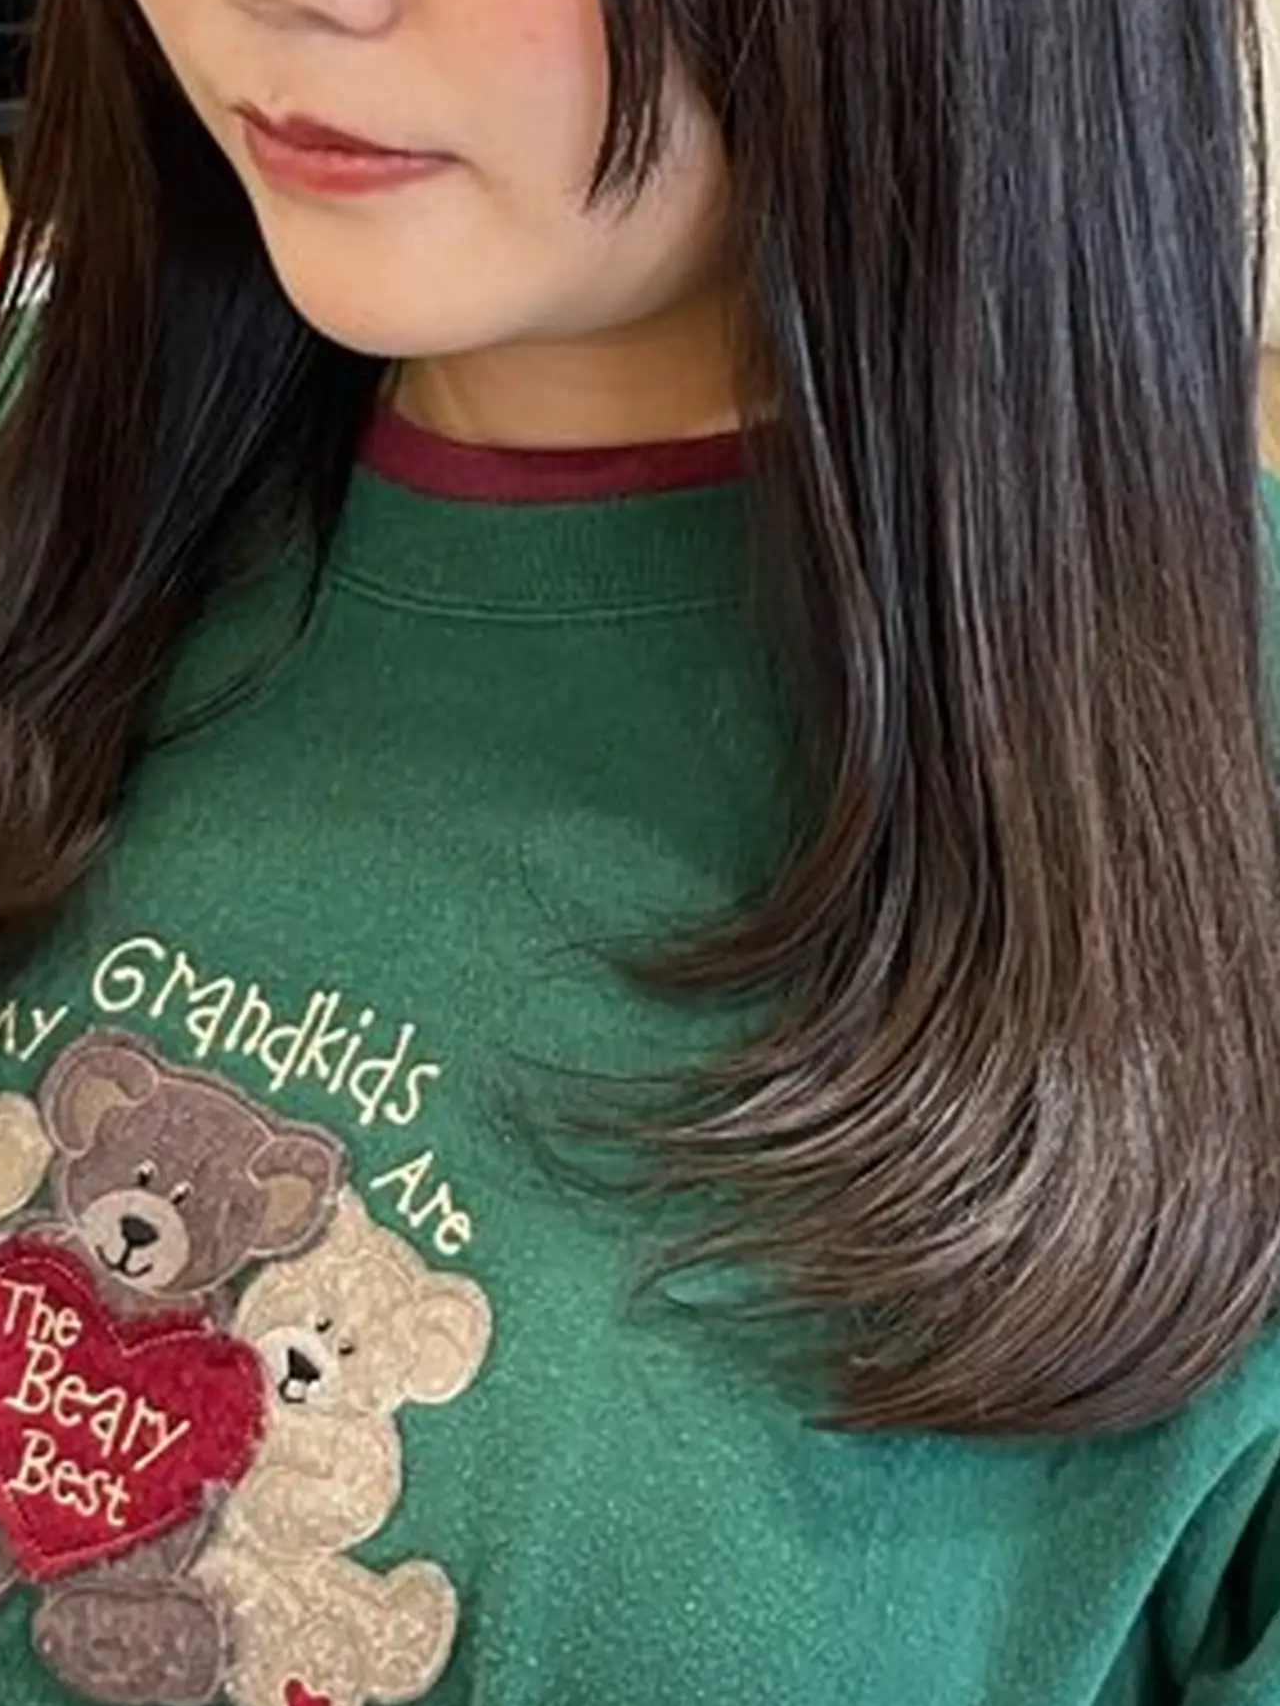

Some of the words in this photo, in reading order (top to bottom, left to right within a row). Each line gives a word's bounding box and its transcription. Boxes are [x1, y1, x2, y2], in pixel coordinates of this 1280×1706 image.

[92, 937, 440, 1125] Grandkids
[370, 1150, 472, 1256] Are
[0, 1278, 82, 1347] The
[4, 1340, 190, 1471] Beary
[6, 1428, 131, 1527] Best
